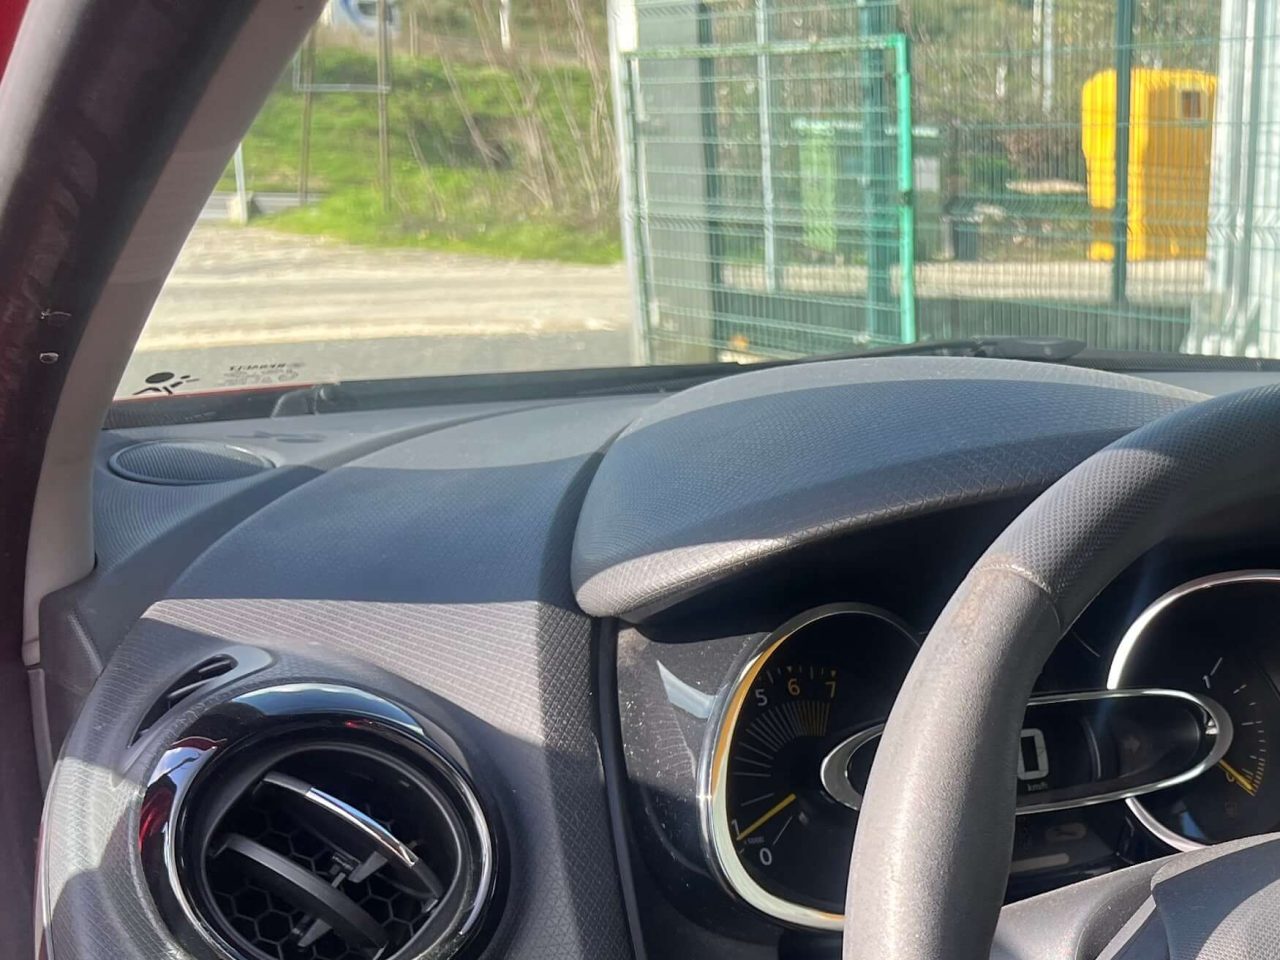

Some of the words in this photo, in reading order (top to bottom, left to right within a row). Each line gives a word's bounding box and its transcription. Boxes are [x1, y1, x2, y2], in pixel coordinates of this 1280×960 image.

[787, 678, 800, 696] 6
[825, 681, 836, 699] 7
[755, 688, 768, 706] 5
[760, 847, 772, 866] 0
